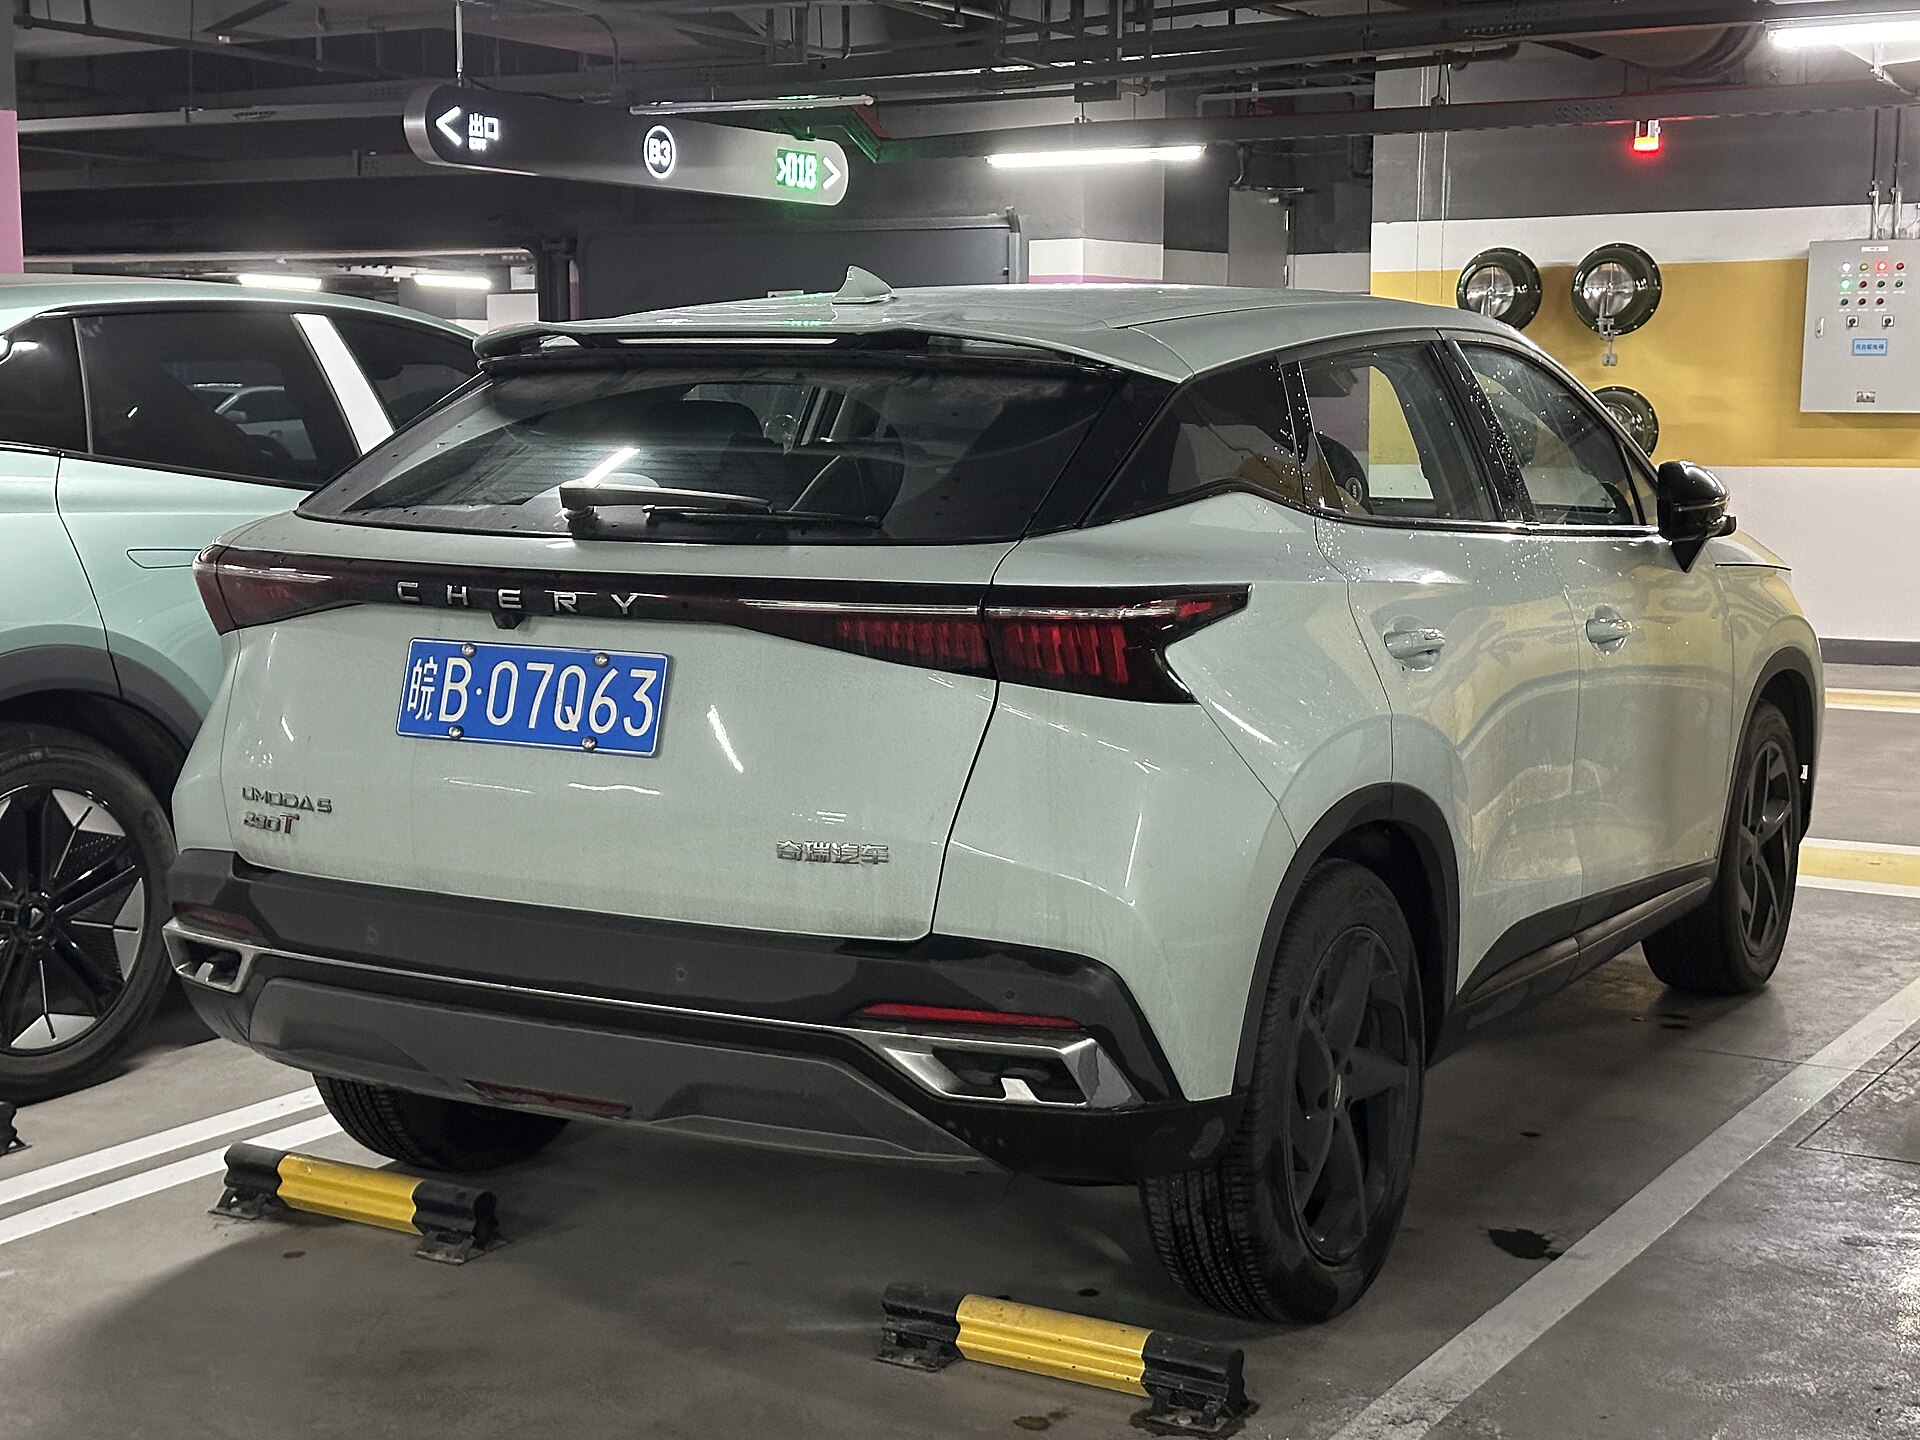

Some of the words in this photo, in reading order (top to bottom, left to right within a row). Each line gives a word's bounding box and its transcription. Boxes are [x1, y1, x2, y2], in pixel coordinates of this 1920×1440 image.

[468, 112, 499, 140] 出口
[647, 137, 672, 166] B3
[396, 581, 639, 614] CHERY
